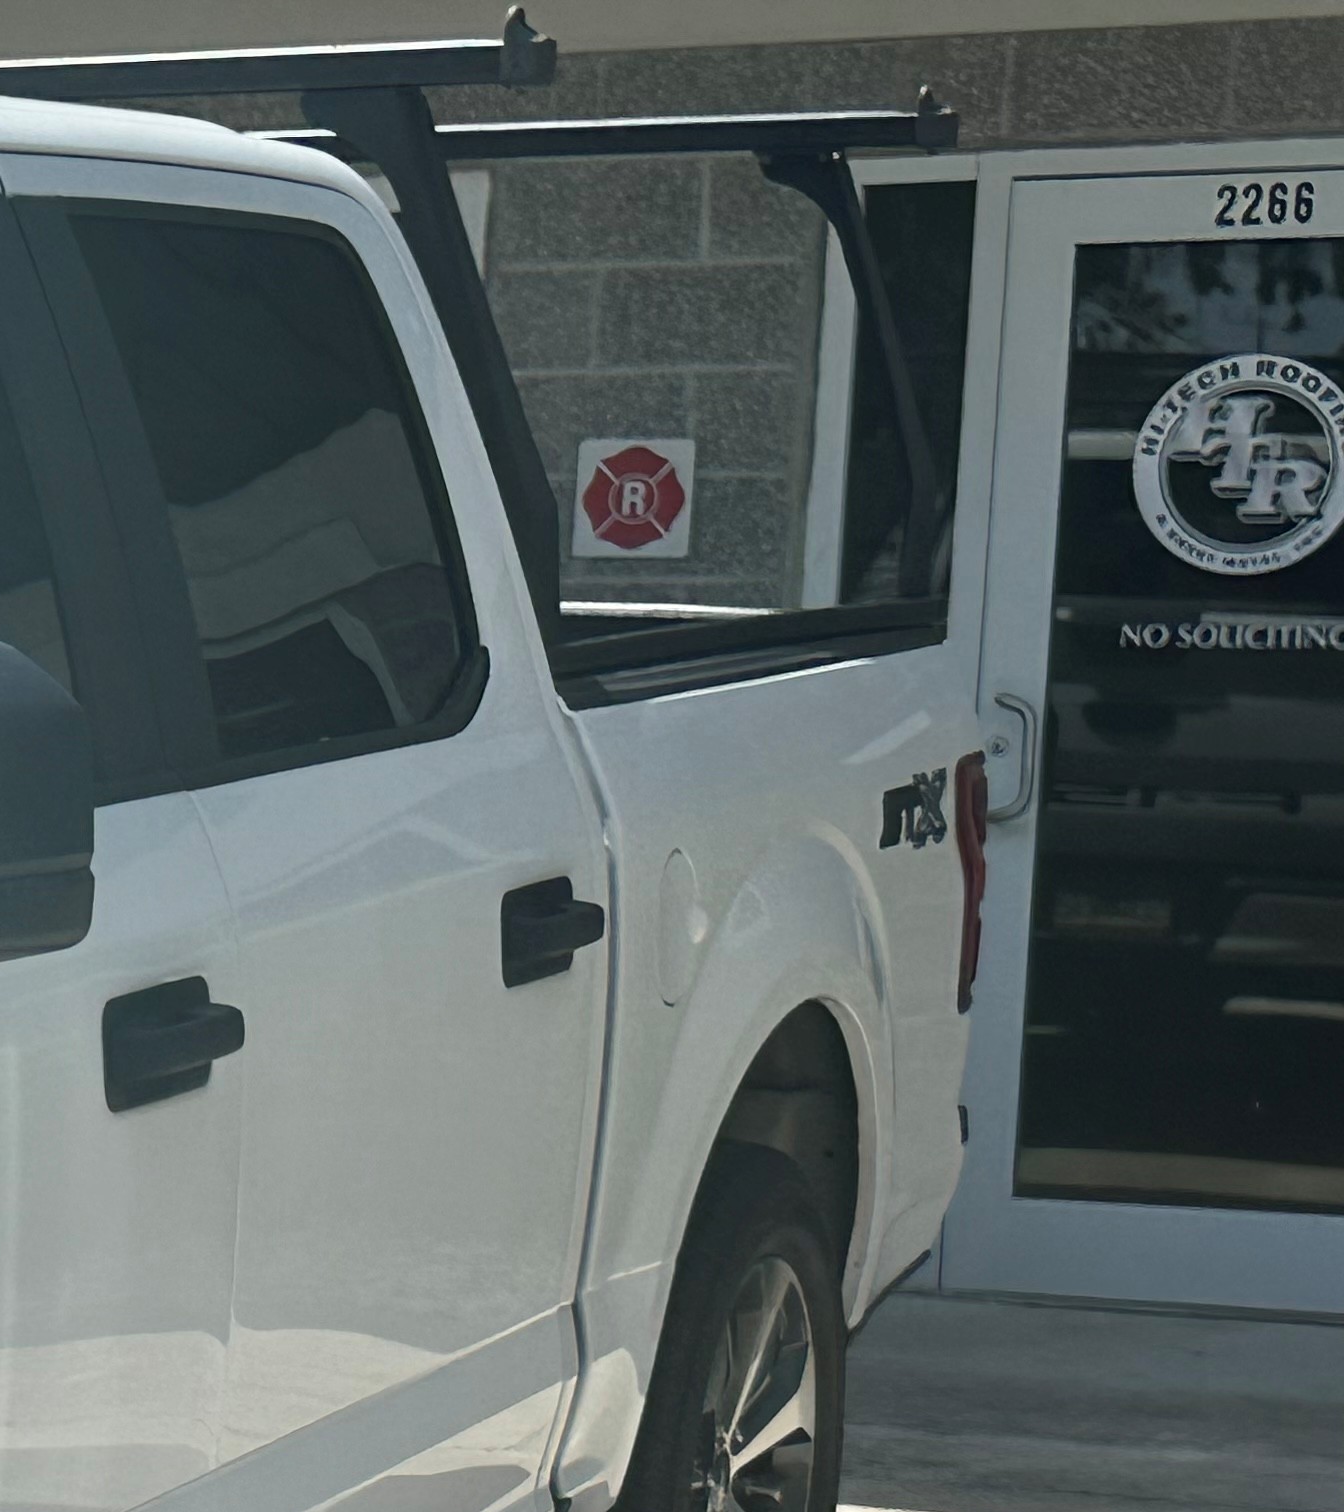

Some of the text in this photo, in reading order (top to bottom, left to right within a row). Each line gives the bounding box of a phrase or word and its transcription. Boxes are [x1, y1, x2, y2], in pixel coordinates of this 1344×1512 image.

[1215, 181, 1315, 227] 2266
[621, 481, 647, 517] R
[1118, 622, 1171, 650] NO
